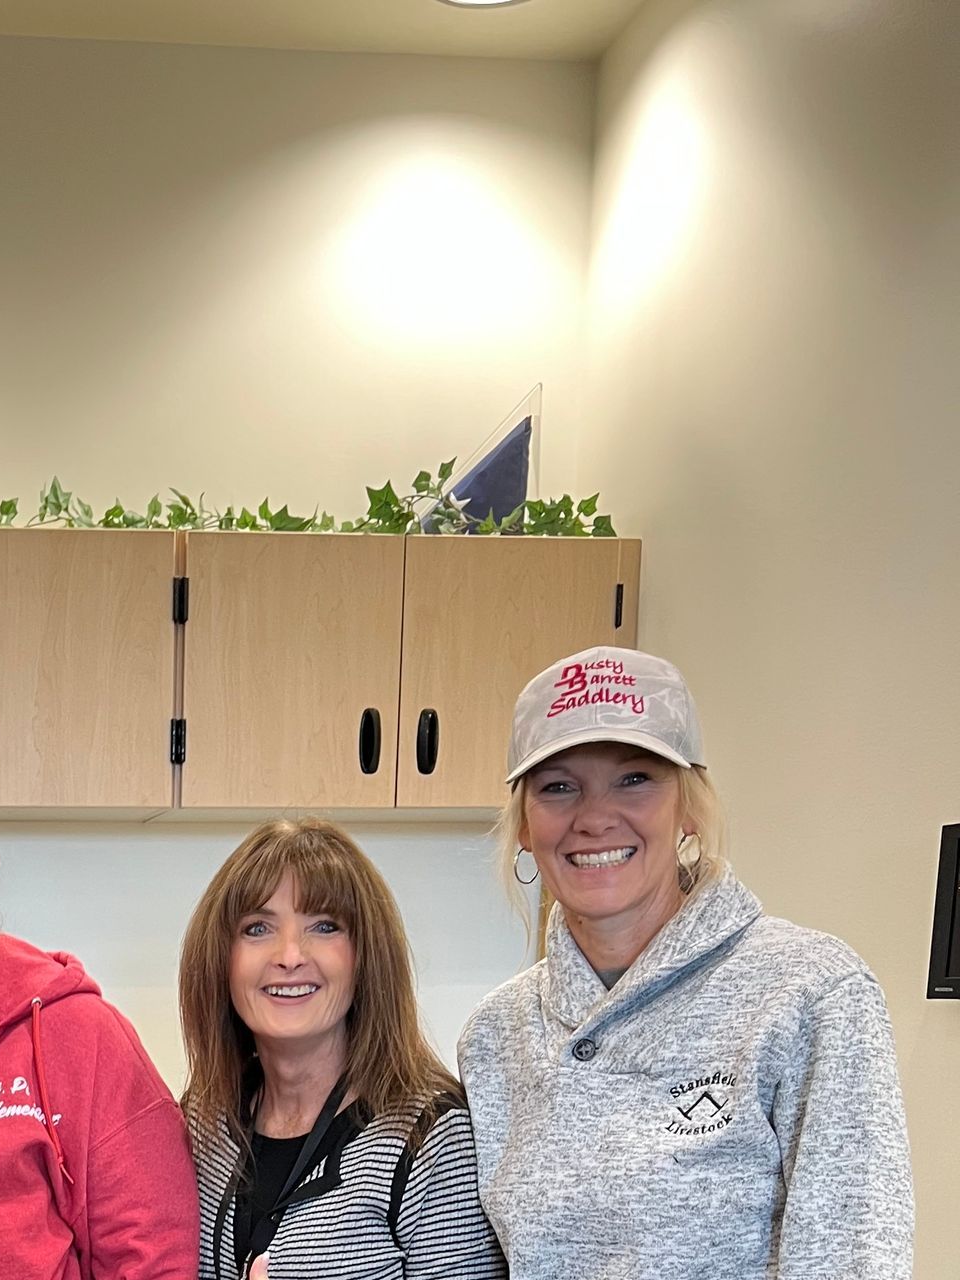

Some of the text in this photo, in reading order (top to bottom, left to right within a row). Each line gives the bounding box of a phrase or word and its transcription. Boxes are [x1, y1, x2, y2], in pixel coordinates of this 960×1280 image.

[554, 671, 637, 697] Barrett
[546, 687, 645, 718] Saddlery
[664, 1113, 733, 1136] Livestock
